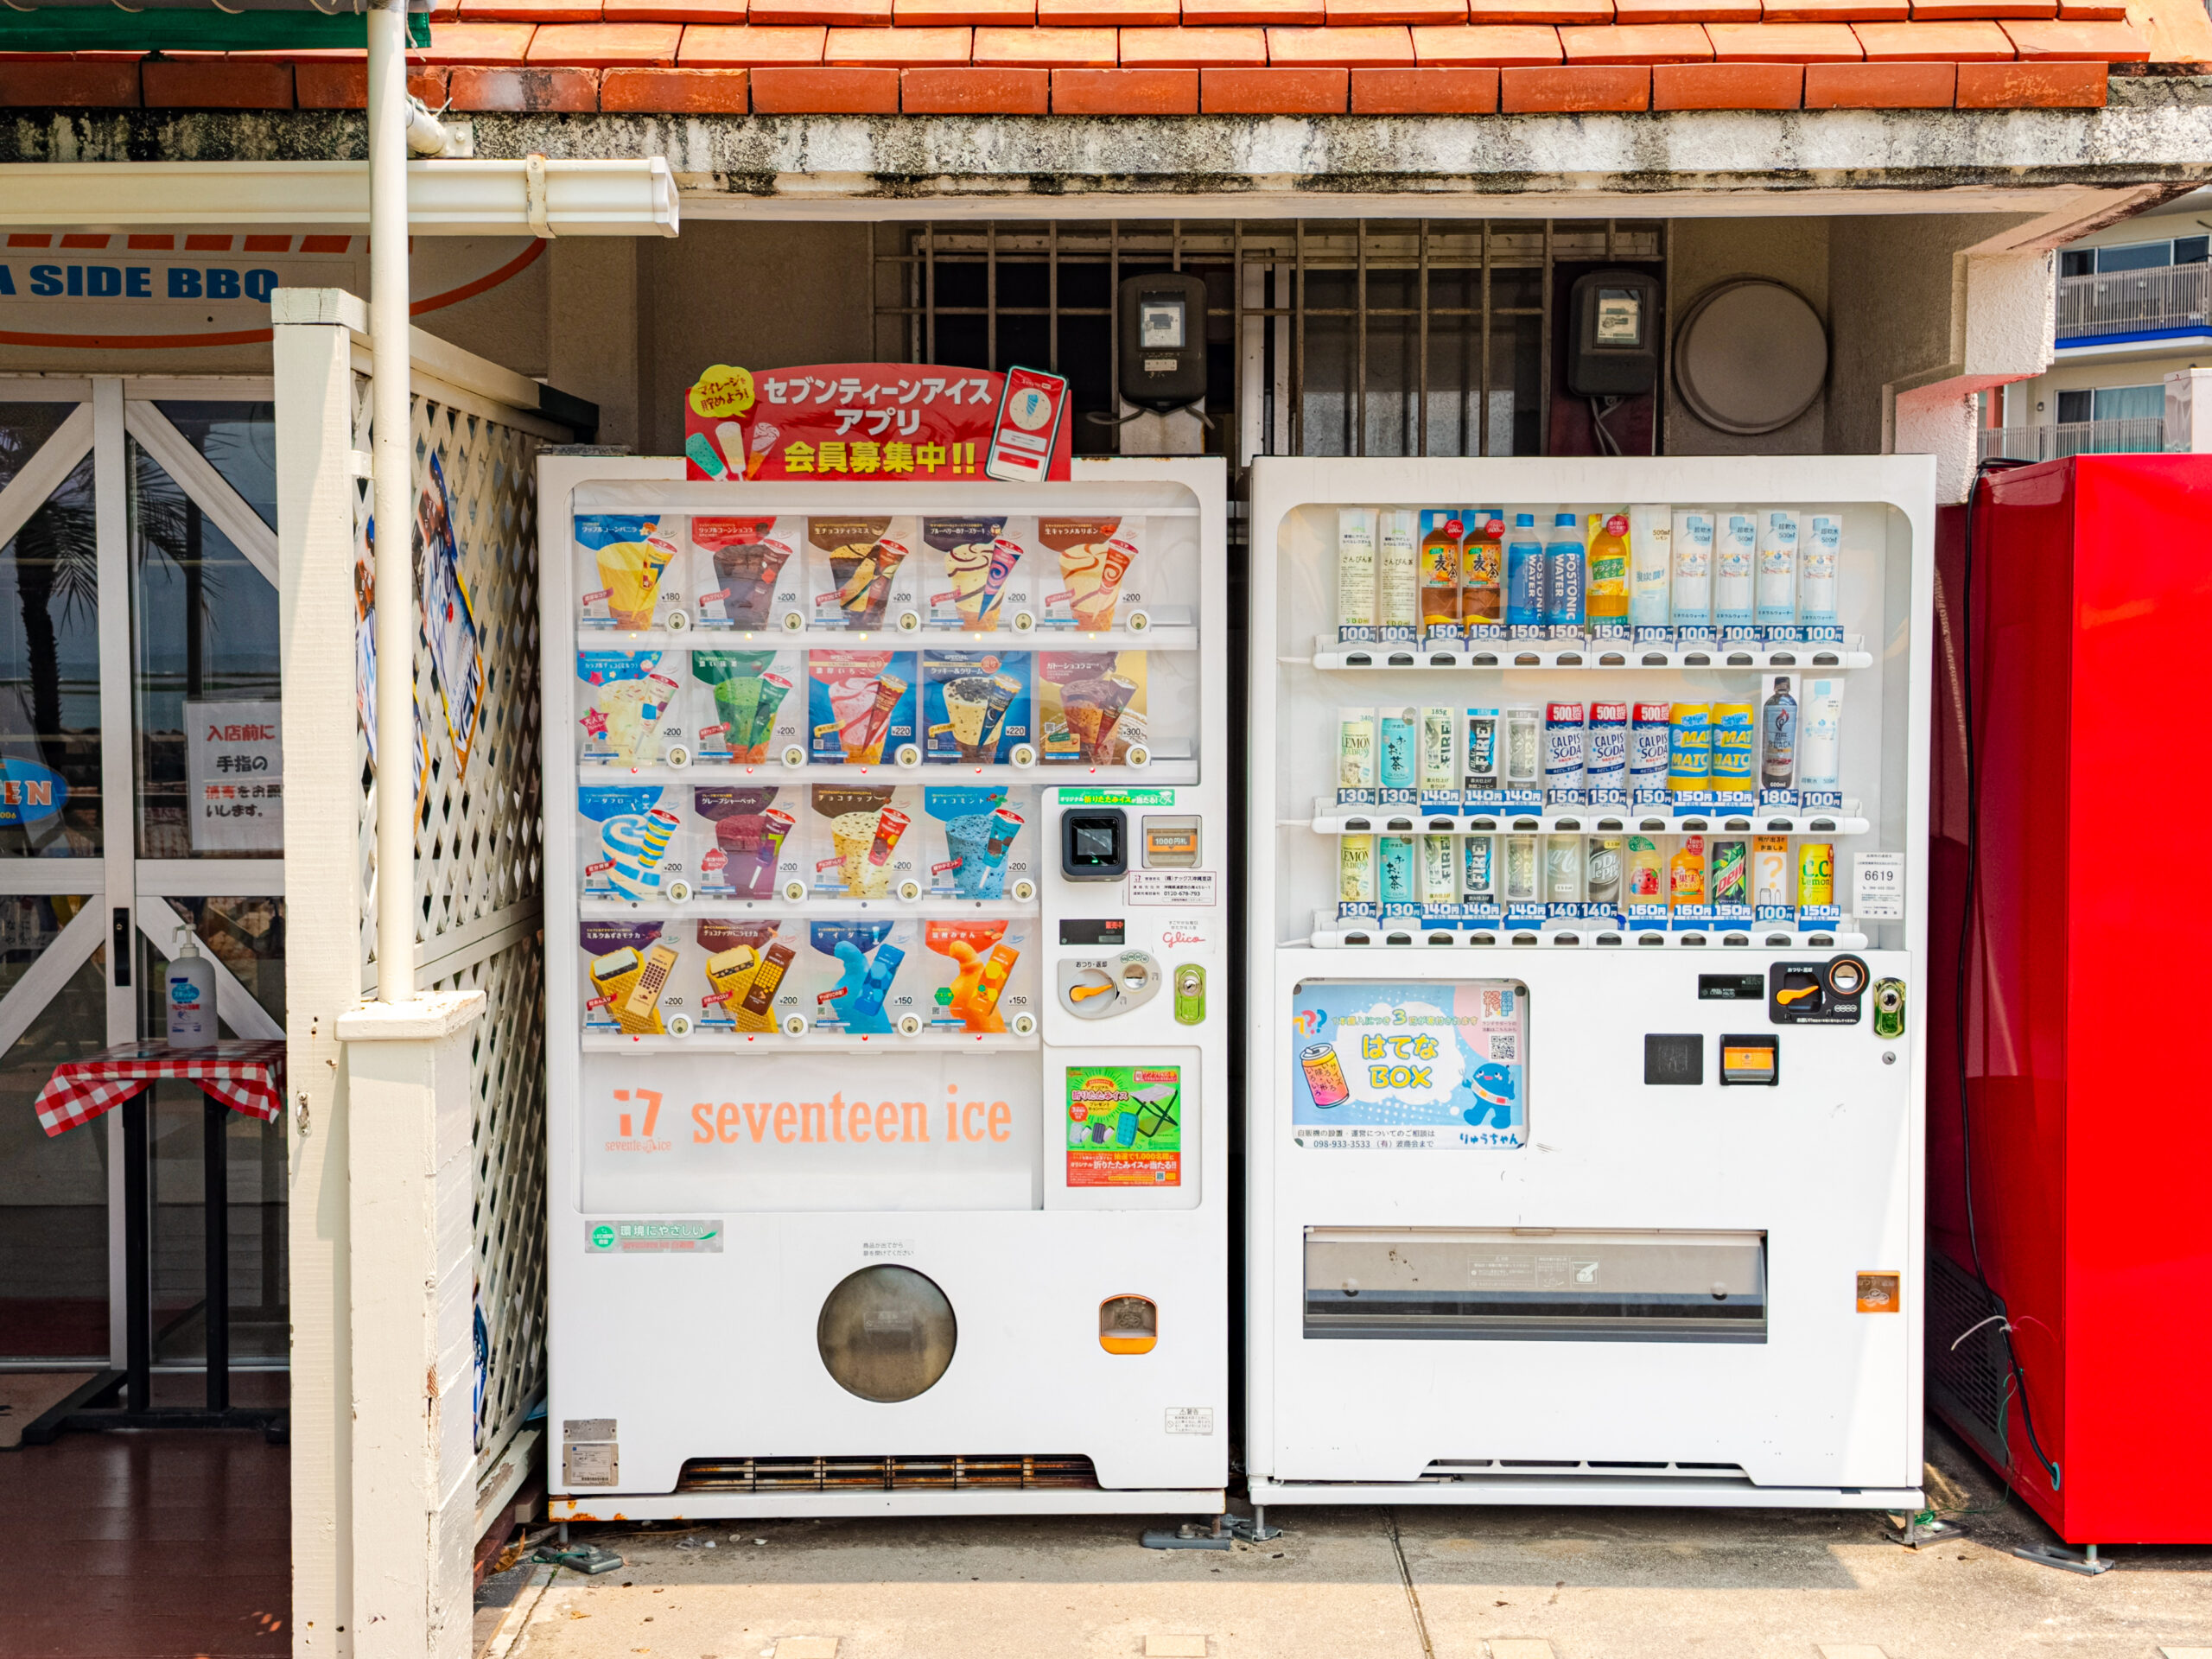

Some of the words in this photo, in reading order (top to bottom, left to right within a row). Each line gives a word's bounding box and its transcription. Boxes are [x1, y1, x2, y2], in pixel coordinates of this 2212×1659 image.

[30, 264, 151, 298] SIDE
[168, 267, 280, 302] BBQ
[763, 378, 992, 405] セブンティーンアイス
[835, 408, 920, 435] アプリ
[784, 441, 976, 474] 会員募集中!!
[1383, 557, 1413, 566] さんぴん茶
[1529, 554, 1537, 597] WATER
[1555, 554, 1565, 597] WATER
[1566, 553, 1578, 620] POSTONIC
[207, 724, 276, 741] 入店前に
[1552, 733, 1580, 747] CALPIS
[1595, 733, 1624, 747] CALPIS
[1639, 733, 1668, 747] CALPIS
[1342, 736, 1370, 748] LEMON
[1440, 725, 1451, 764] FIRE
[1476, 727, 1491, 766] FIRE
[1554, 744, 1581, 760] SODA
[1597, 744, 1624, 760] SODA
[1641, 744, 1668, 760] SODA
[217, 755, 268, 772] 手指の
[207, 804, 263, 817] いします。
[1341, 849, 1369, 861] LEMON
[1803, 860, 1831, 877] C.C.
[1865, 870, 1893, 881] 6619
[1163, 932, 1205, 947] Glico
[1363, 1033, 1439, 1059] はてな
[1369, 1065, 1432, 1089] BOX
[1071, 1090, 1128, 1101] 折りたたみイス
[691, 1090, 930, 1144] seventeen
[946, 1084, 1012, 1143] ice
[1313, 1140, 1370, 1148] 098-933-3533
[1459, 1134, 1519, 1145] りゅうちゃん
[620, 1224, 704, 1237] 環境にやさしい
